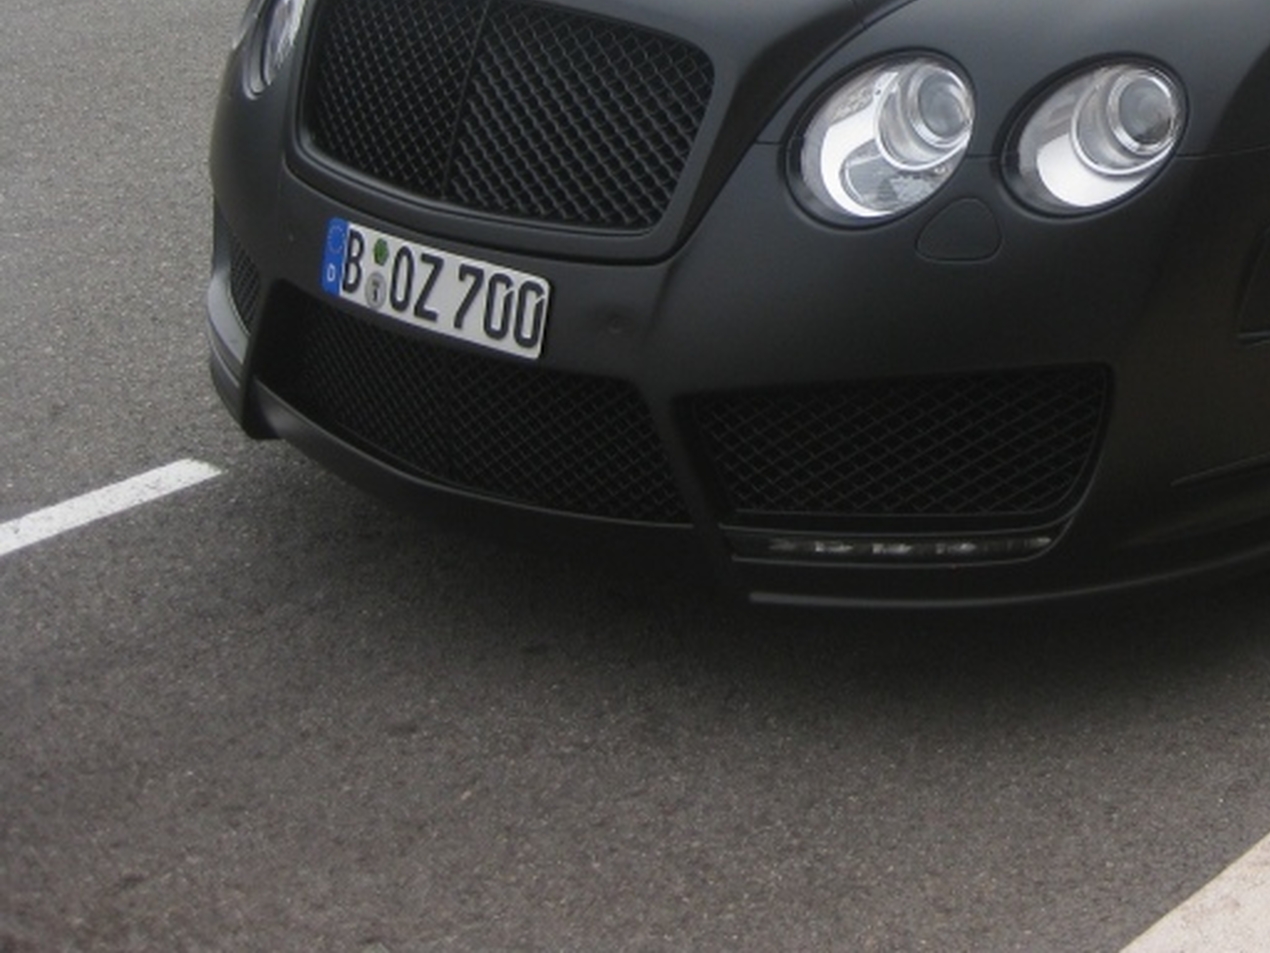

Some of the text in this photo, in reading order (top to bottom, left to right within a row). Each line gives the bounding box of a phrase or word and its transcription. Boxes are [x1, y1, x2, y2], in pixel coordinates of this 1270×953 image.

[342, 229, 545, 349] B OZ 700
